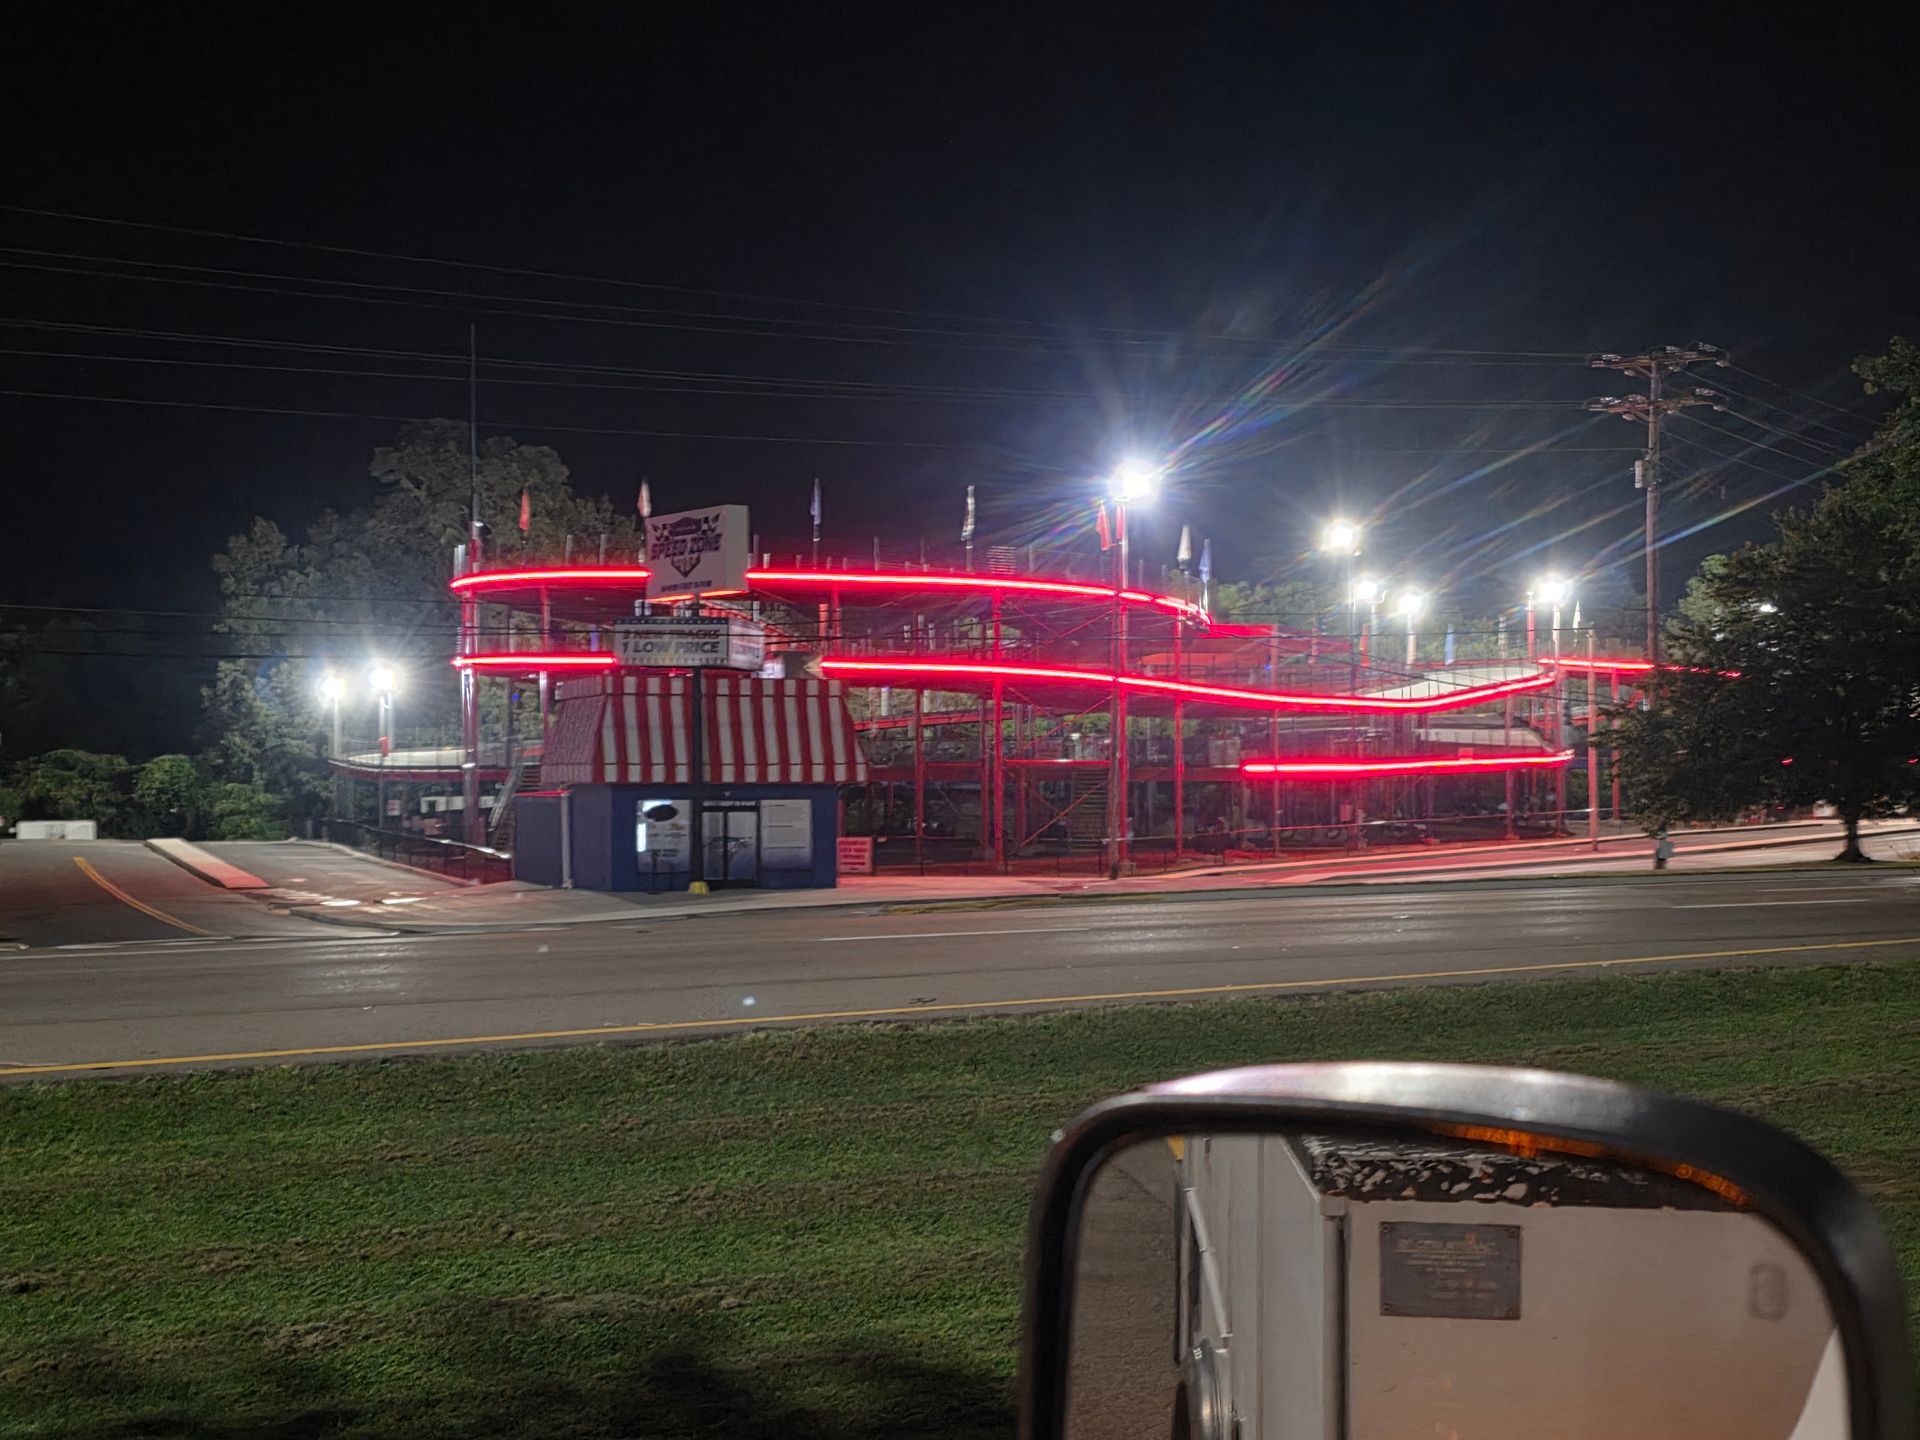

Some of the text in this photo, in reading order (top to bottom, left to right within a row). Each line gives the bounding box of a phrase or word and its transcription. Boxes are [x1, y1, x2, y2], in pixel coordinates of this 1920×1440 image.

[651, 533, 722, 560] SPEED ZONE
[633, 641, 671, 653] LOW
[674, 641, 720, 653] PRICE
